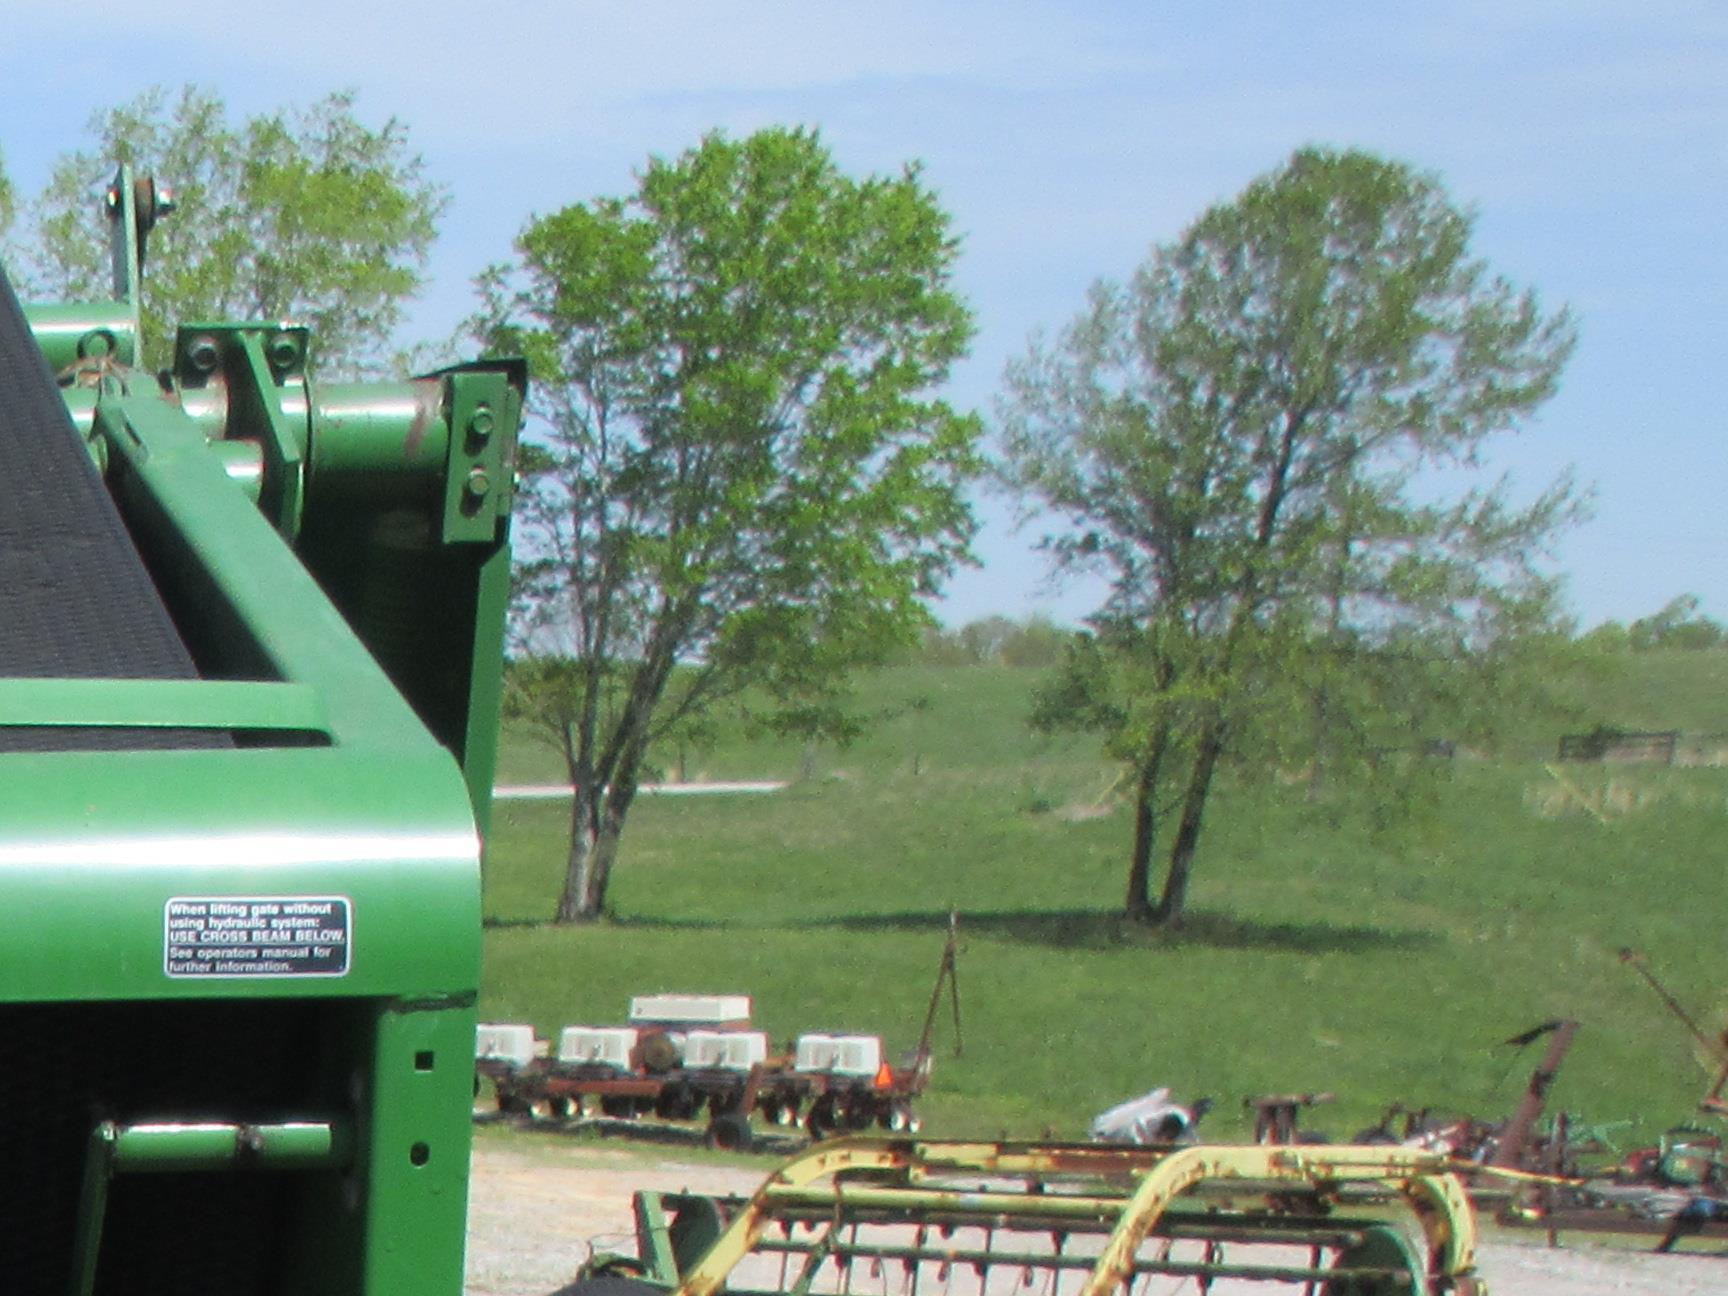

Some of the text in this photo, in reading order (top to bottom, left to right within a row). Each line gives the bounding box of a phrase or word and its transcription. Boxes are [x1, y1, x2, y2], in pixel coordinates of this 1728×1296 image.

[171, 903, 331, 917] When lifting gate without
[170, 917, 319, 931] using hydraulic system:
[170, 931, 344, 942] USE CROSS BEAM BELOW.
[170, 947, 331, 960] See operators manual for
[169, 961, 293, 972] further information.
